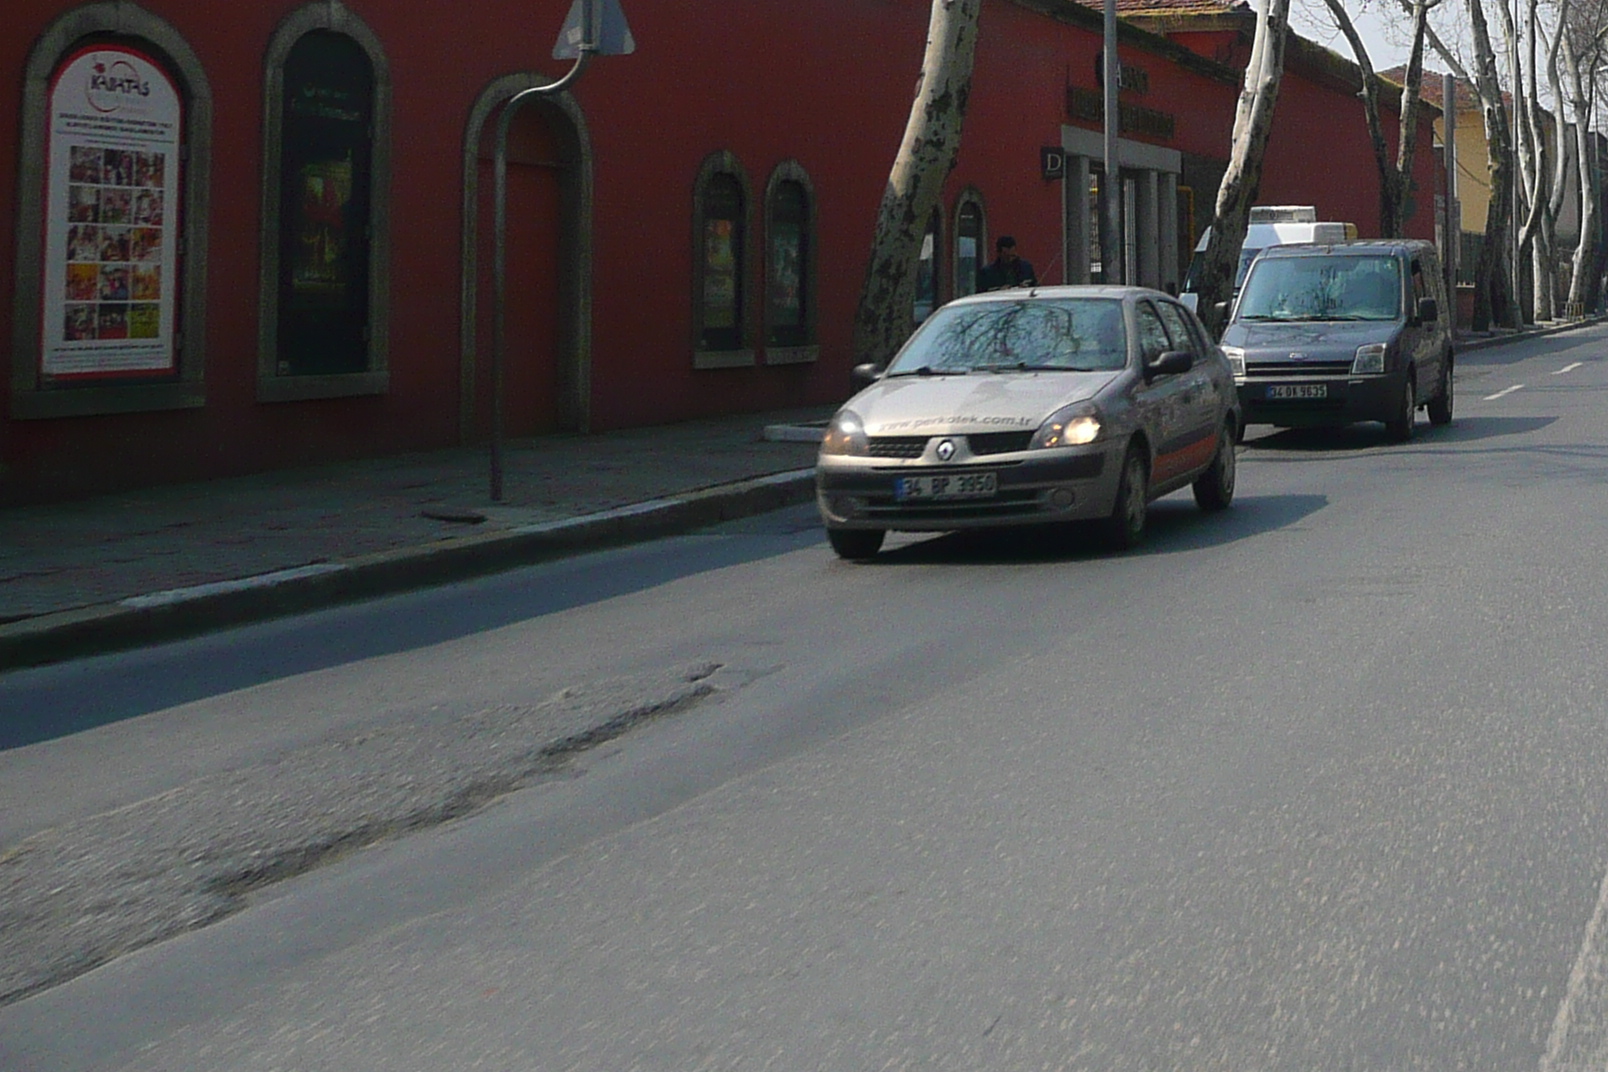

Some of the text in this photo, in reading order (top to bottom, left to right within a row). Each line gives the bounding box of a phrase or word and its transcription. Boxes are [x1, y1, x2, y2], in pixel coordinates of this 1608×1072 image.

[1047, 153, 1062, 171] D
[879, 414, 1033, 432] www.perkotek.com.tr
[903, 475, 996, 496] 34 BP 3950
